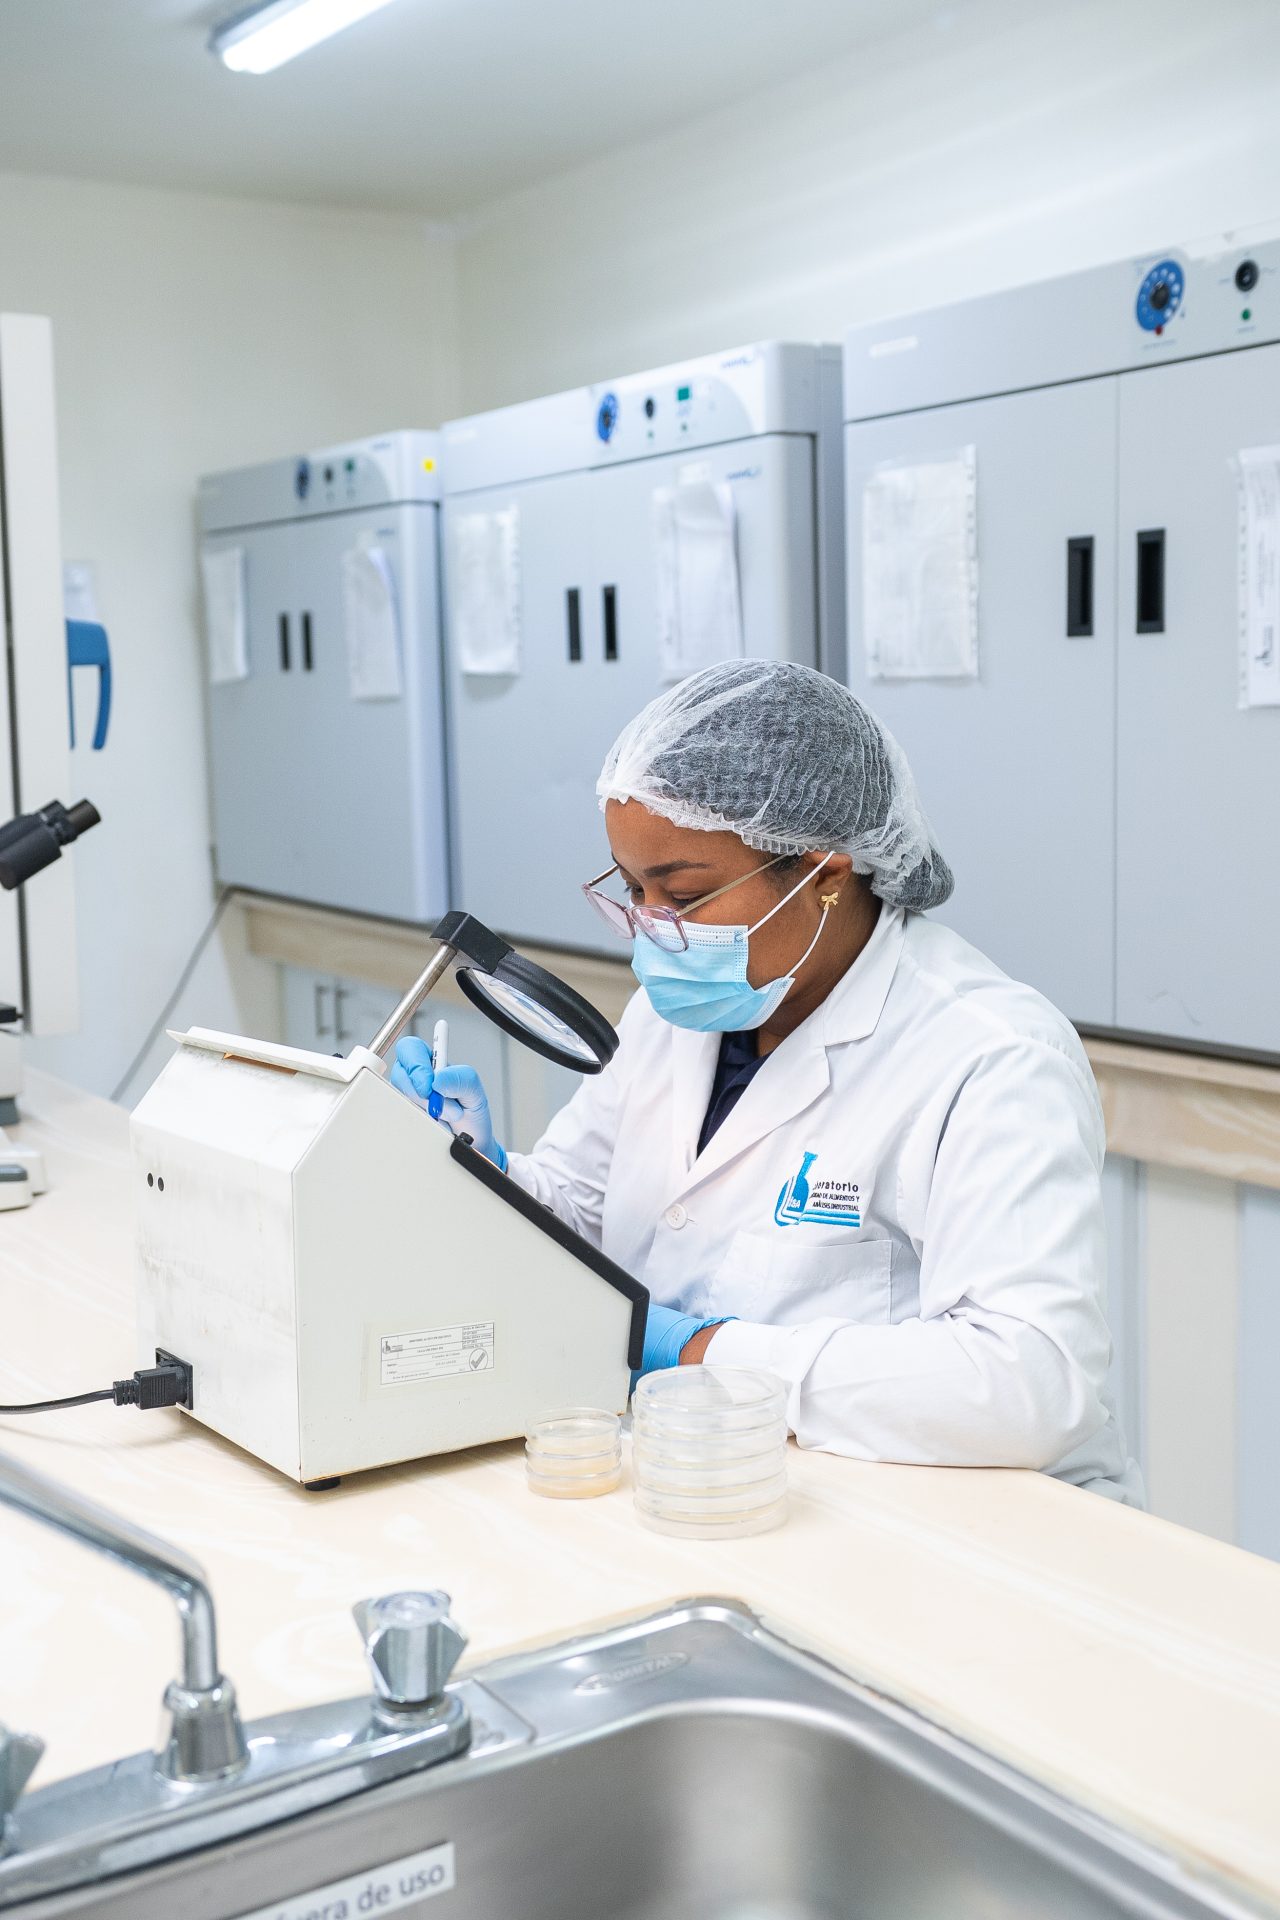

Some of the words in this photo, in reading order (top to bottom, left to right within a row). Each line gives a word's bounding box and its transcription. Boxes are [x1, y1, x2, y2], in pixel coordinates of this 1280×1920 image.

[829, 1193, 855, 1202] ALIMENTOS
[831, 1203, 859, 1212] INDUSTRIAL
[357, 1882, 391, 1912] de
[399, 1863, 446, 1897] uso
